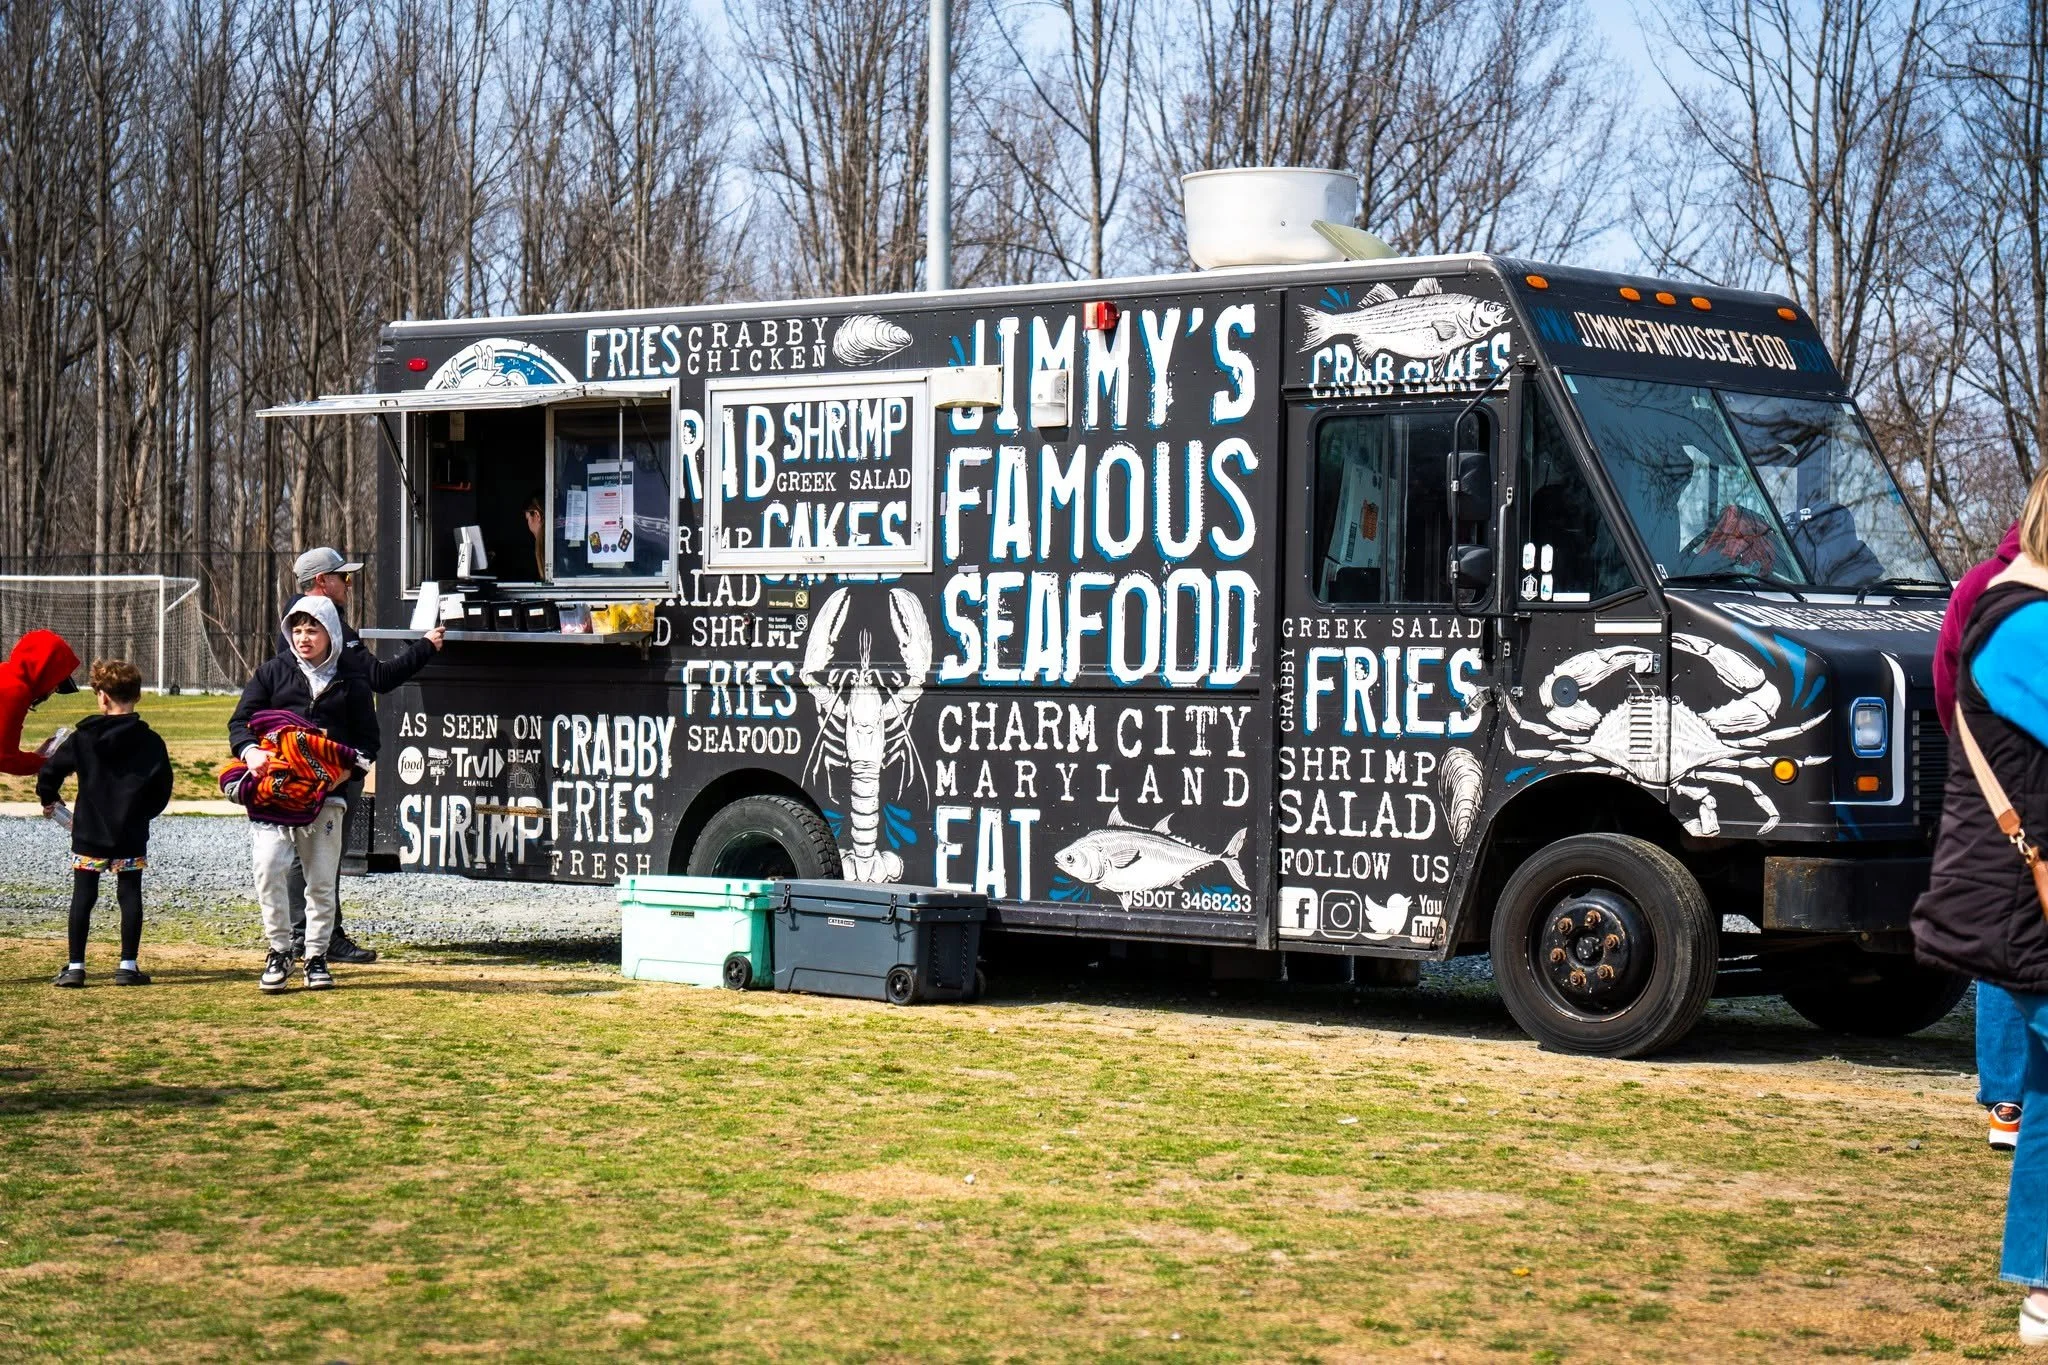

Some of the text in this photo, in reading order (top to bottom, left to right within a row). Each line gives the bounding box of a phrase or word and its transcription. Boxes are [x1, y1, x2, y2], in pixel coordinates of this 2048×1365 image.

[587, 325, 681, 379] FRIES
[688, 317, 828, 350] CRABBY
[1574, 311, 1797, 371] JIMMYSFAMOUSSEAFOOD
[688, 345, 827, 375] CHICKEN
[945, 303, 1258, 434] JIMMY'S
[1312, 344, 1394, 398] CRAB
[783, 397, 907, 461] SHRIMP
[776, 468, 911, 492] GREEK SALAD
[944, 438, 1259, 562] FAMOUS
[941, 567, 1260, 688] SEAFOOD
[1282, 617, 1482, 639] GREEK SALAD
[682, 660, 799, 718] FRIES
[1279, 647, 1295, 732] CRABBY
[1304, 646, 1484, 737] FRIES
[399, 711, 542, 740] AS SEEN ON
[551, 714, 676, 780] CRABBY
[688, 725, 801, 755] SEAFOOD
[938, 701, 1252, 758] CHARM CITY
[507, 748, 541, 763] BEAT
[1280, 746, 1436, 787] SHRIMP
[463, 779, 494, 788] CHANNEL
[935, 760, 1250, 808] MARYLAND
[400, 794, 543, 870] SHRIMP
[551, 781, 654, 845] FRIES
[1280, 790, 1436, 840] SALAD
[551, 849, 652, 879] FRESH
[935, 806, 1041, 900] EAT
[1280, 848, 1450, 884] FOLLOW US
[1180, 892, 1252, 913] 3468233
[1418, 894, 1443, 915] You
